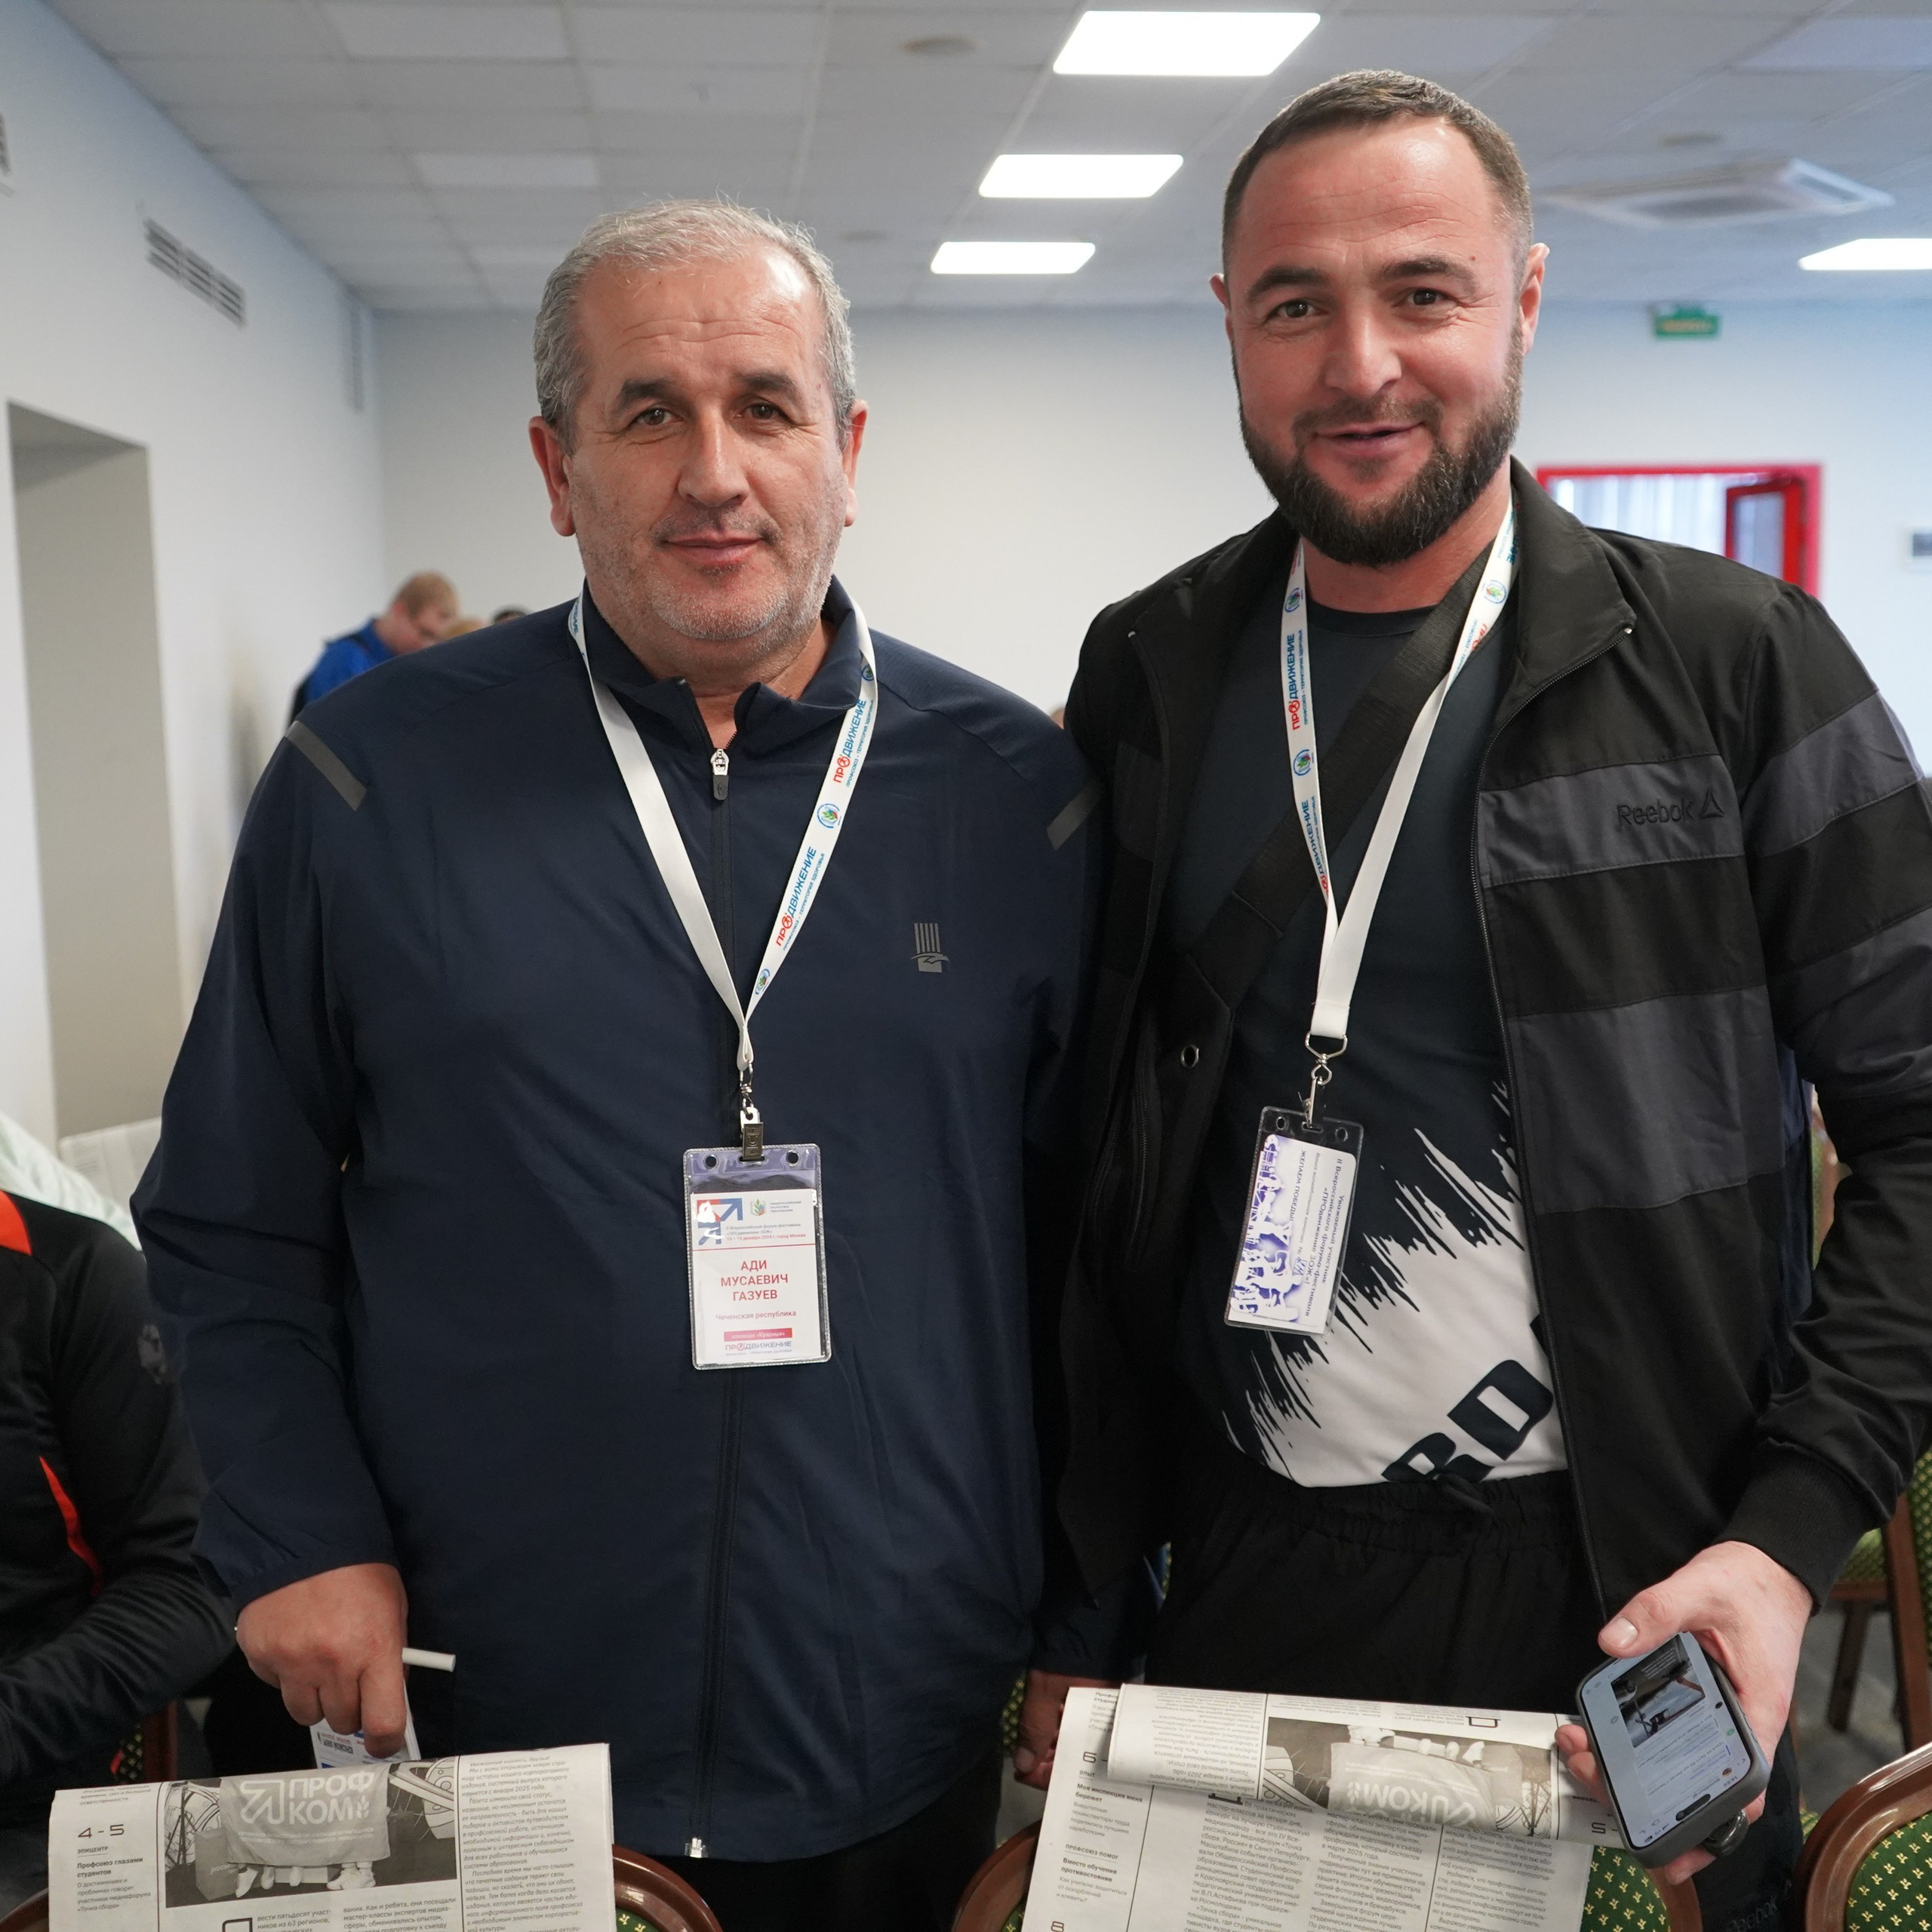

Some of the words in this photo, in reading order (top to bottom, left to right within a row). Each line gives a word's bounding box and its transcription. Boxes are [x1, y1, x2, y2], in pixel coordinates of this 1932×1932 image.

[1617, 797, 1694, 827] Reebok
[1296, 1150, 1306, 1183] ЖЕЛАЕМ
[1289, 1186, 1300, 1221] ПОБЕДЫ!
[1324, 1166, 1341, 1231] Всероссийского
[1331, 1195, 1344, 1244] Уважаемый
[740, 1260, 767, 1272] АДИ
[1322, 1247, 1333, 1283] участник
[721, 1274, 788, 1286] МУСАЕВИЧ
[1306, 1233, 1327, 1316] форума-фестиваля
[733, 1289, 777, 1300] ГАЗУЕВ
[755, 1310, 796, 1318] республика
[1083, 1751, 1097, 1764] 6
[289, 1770, 376, 1799] ПРОФ
[1091, 1787, 1125, 1798] инспекция
[289, 1796, 354, 1825] КОМ
[78, 1827, 92, 1838] 4
[109, 1824, 125, 1836] 5
[1066, 1844, 1097, 1855] ПРОФСОЮЗ
[77, 1860, 112, 1869] Профсоюз
[1063, 1857, 1086, 1867] Вместо
[1087, 1864, 1117, 1874] обучения
[77, 1869, 111, 1878] студентов
[1061, 1867, 1112, 1881] противостояние
[297, 1918, 330, 1927] регионов,
[343, 1912, 392, 1921] мастер-классы
